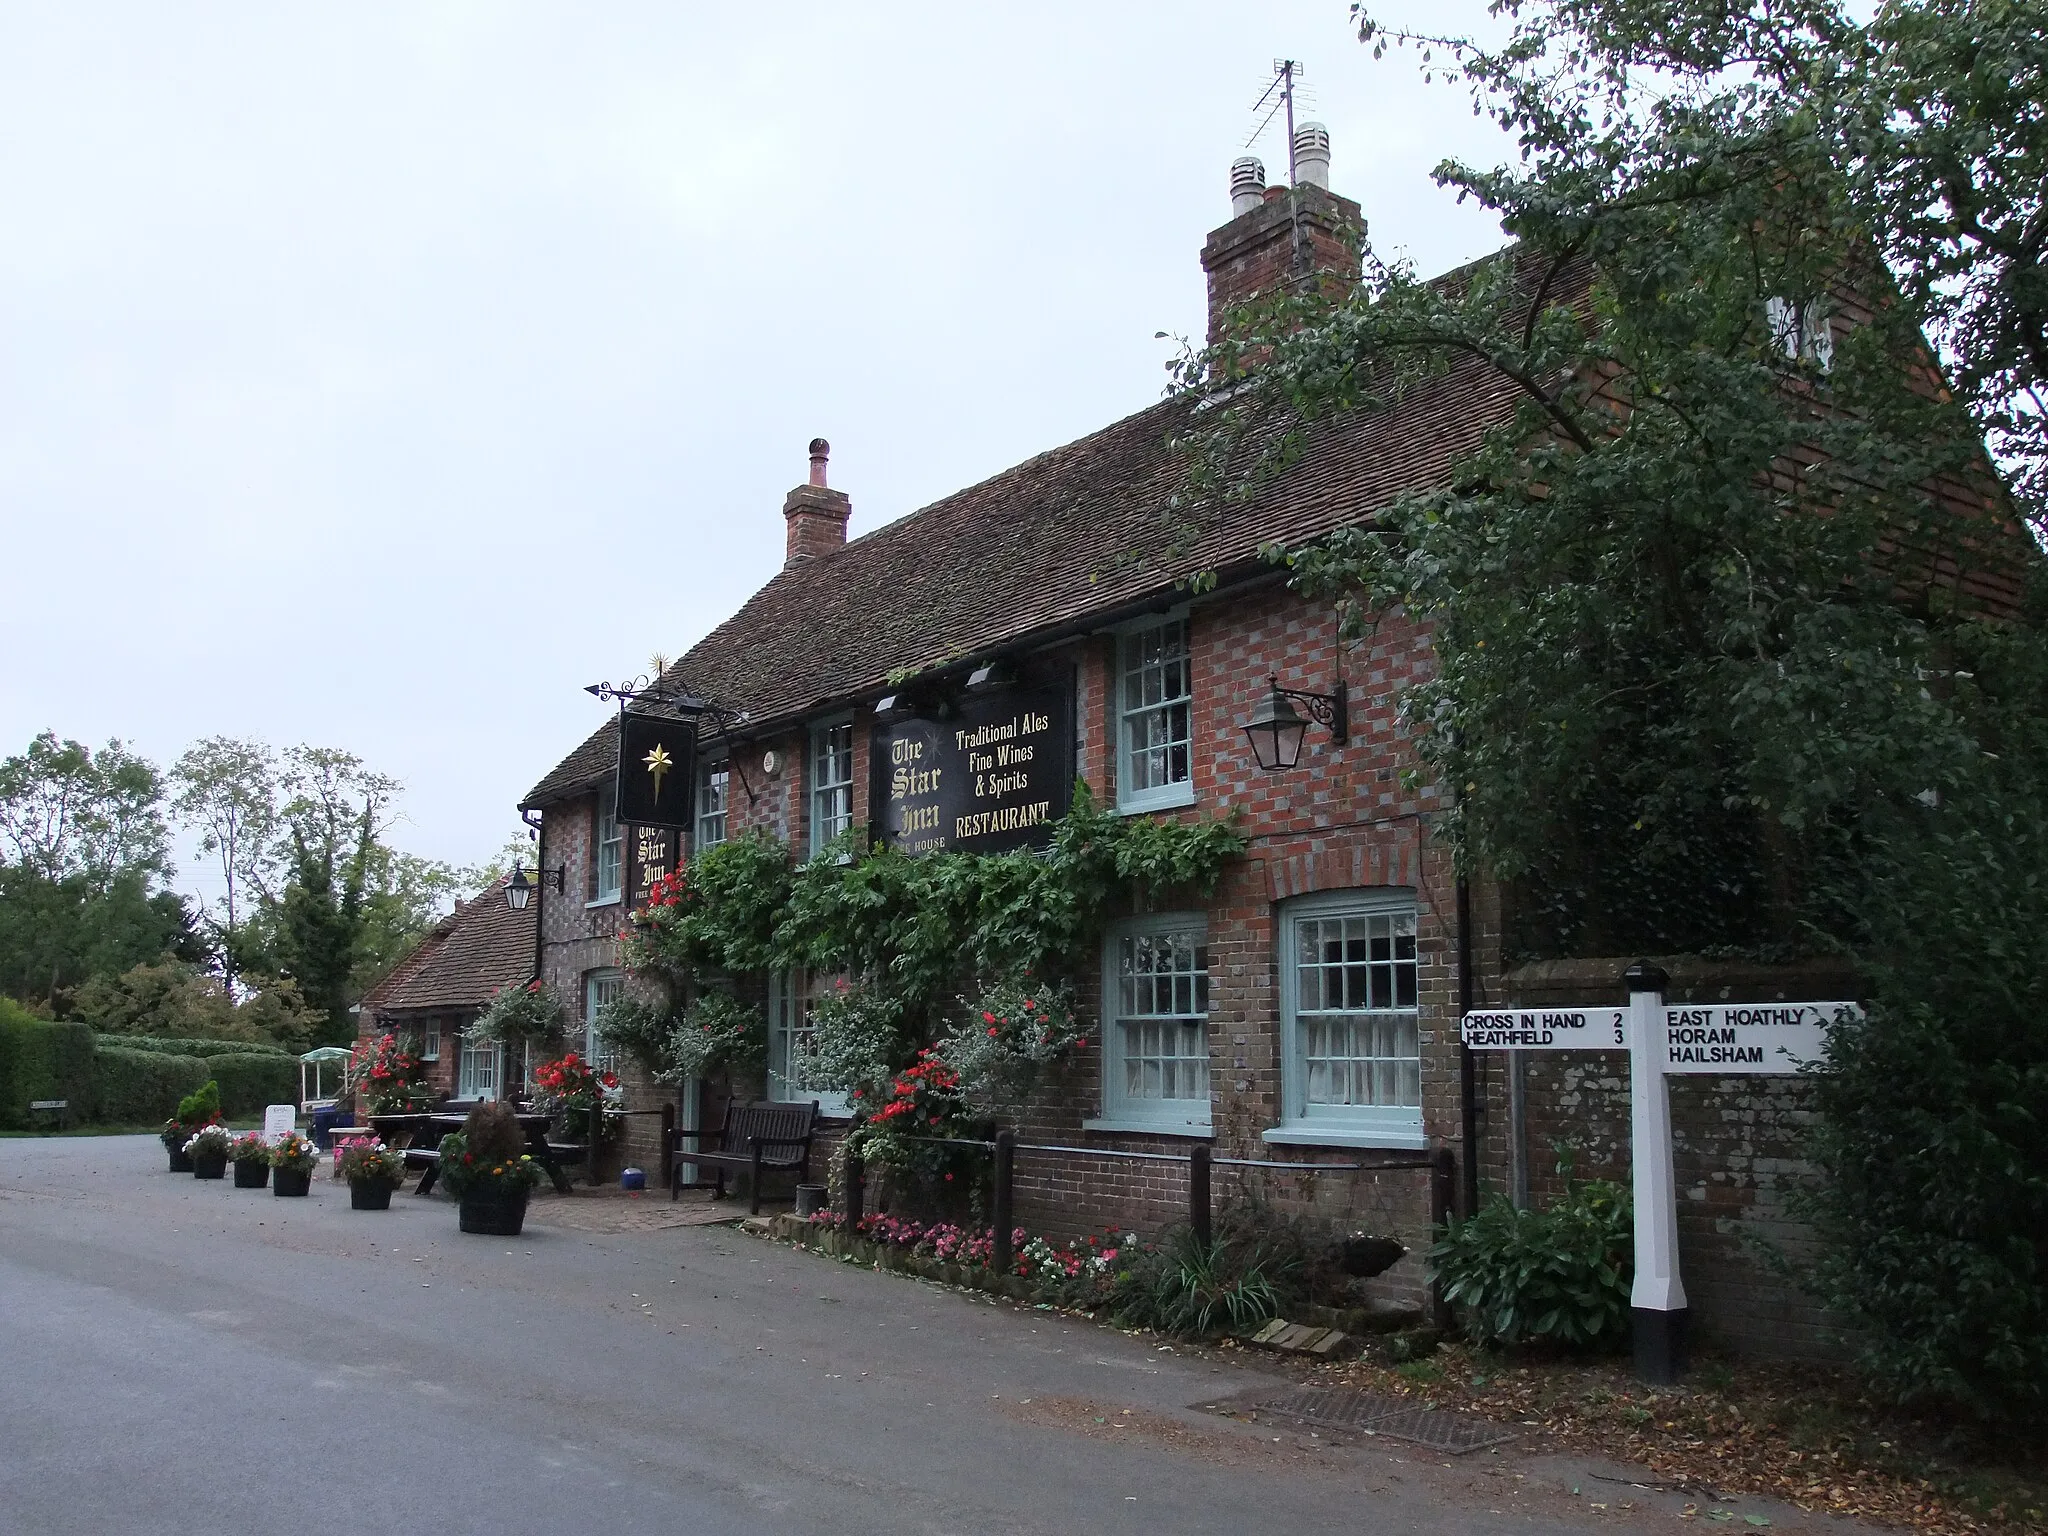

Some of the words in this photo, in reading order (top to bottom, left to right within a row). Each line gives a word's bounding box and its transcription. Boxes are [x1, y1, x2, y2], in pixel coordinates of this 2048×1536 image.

[956, 716, 1017, 751] Traditional
[1021, 712, 1049, 735] Ales
[891, 738, 923, 767] The
[969, 752, 993, 773] Fine
[997, 744, 1034, 767] Wines
[891, 767, 942, 801] Star
[975, 774, 985, 797] &
[989, 771, 1028, 799] Spirits
[898, 804, 940, 838] Inn
[956, 801, 1050, 839] RESTAURANT
[637, 840, 666, 864] Star
[914, 836, 946, 853] HOUSE
[641, 864, 666, 887] Inn
[1464, 1014, 1514, 1030] CROSS
[1520, 1014, 1535, 1029] IN
[1542, 1013, 1586, 1029] HAND
[1613, 1012, 1623, 1028] 2
[1667, 1010, 1713, 1027] EAST
[1724, 1008, 1805, 1026] HOATHLY
[1466, 1030, 1553, 1045] HEATHFIELD
[1614, 1029, 1624, 1044] 3
[1668, 1028, 1736, 1044] HORAM
[1669, 1046, 1764, 1063] HAILSHAM
